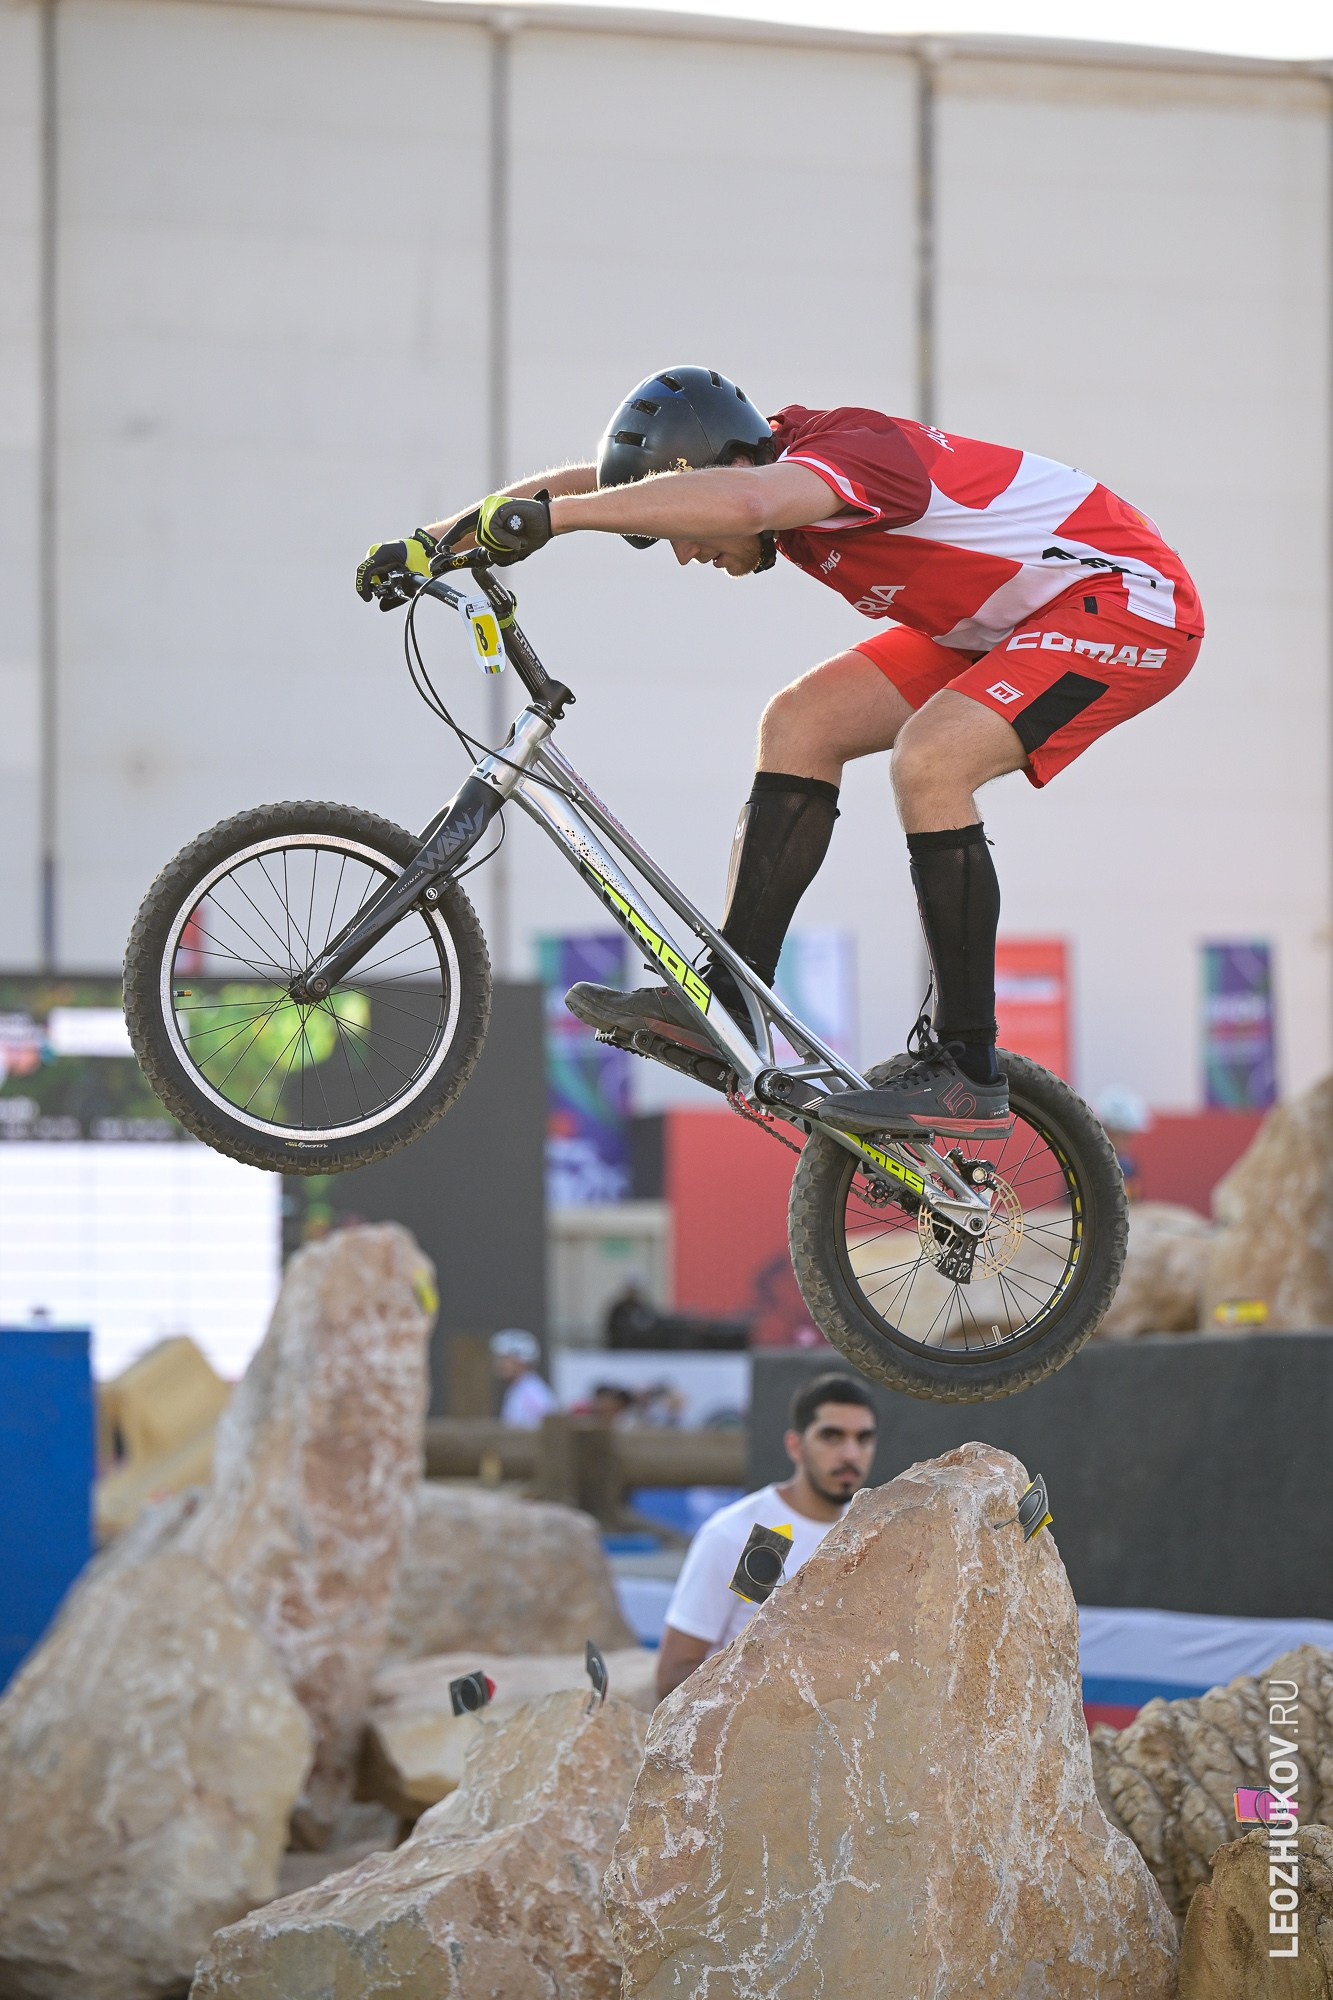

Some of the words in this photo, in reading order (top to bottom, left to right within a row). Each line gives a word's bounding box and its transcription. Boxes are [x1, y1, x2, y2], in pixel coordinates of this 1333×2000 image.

[475, 622, 489, 651] 8
[1005, 631, 1168, 669] COMAS
[416, 802, 485, 872] WAW
[397, 869, 425, 895] ULTIMATE
